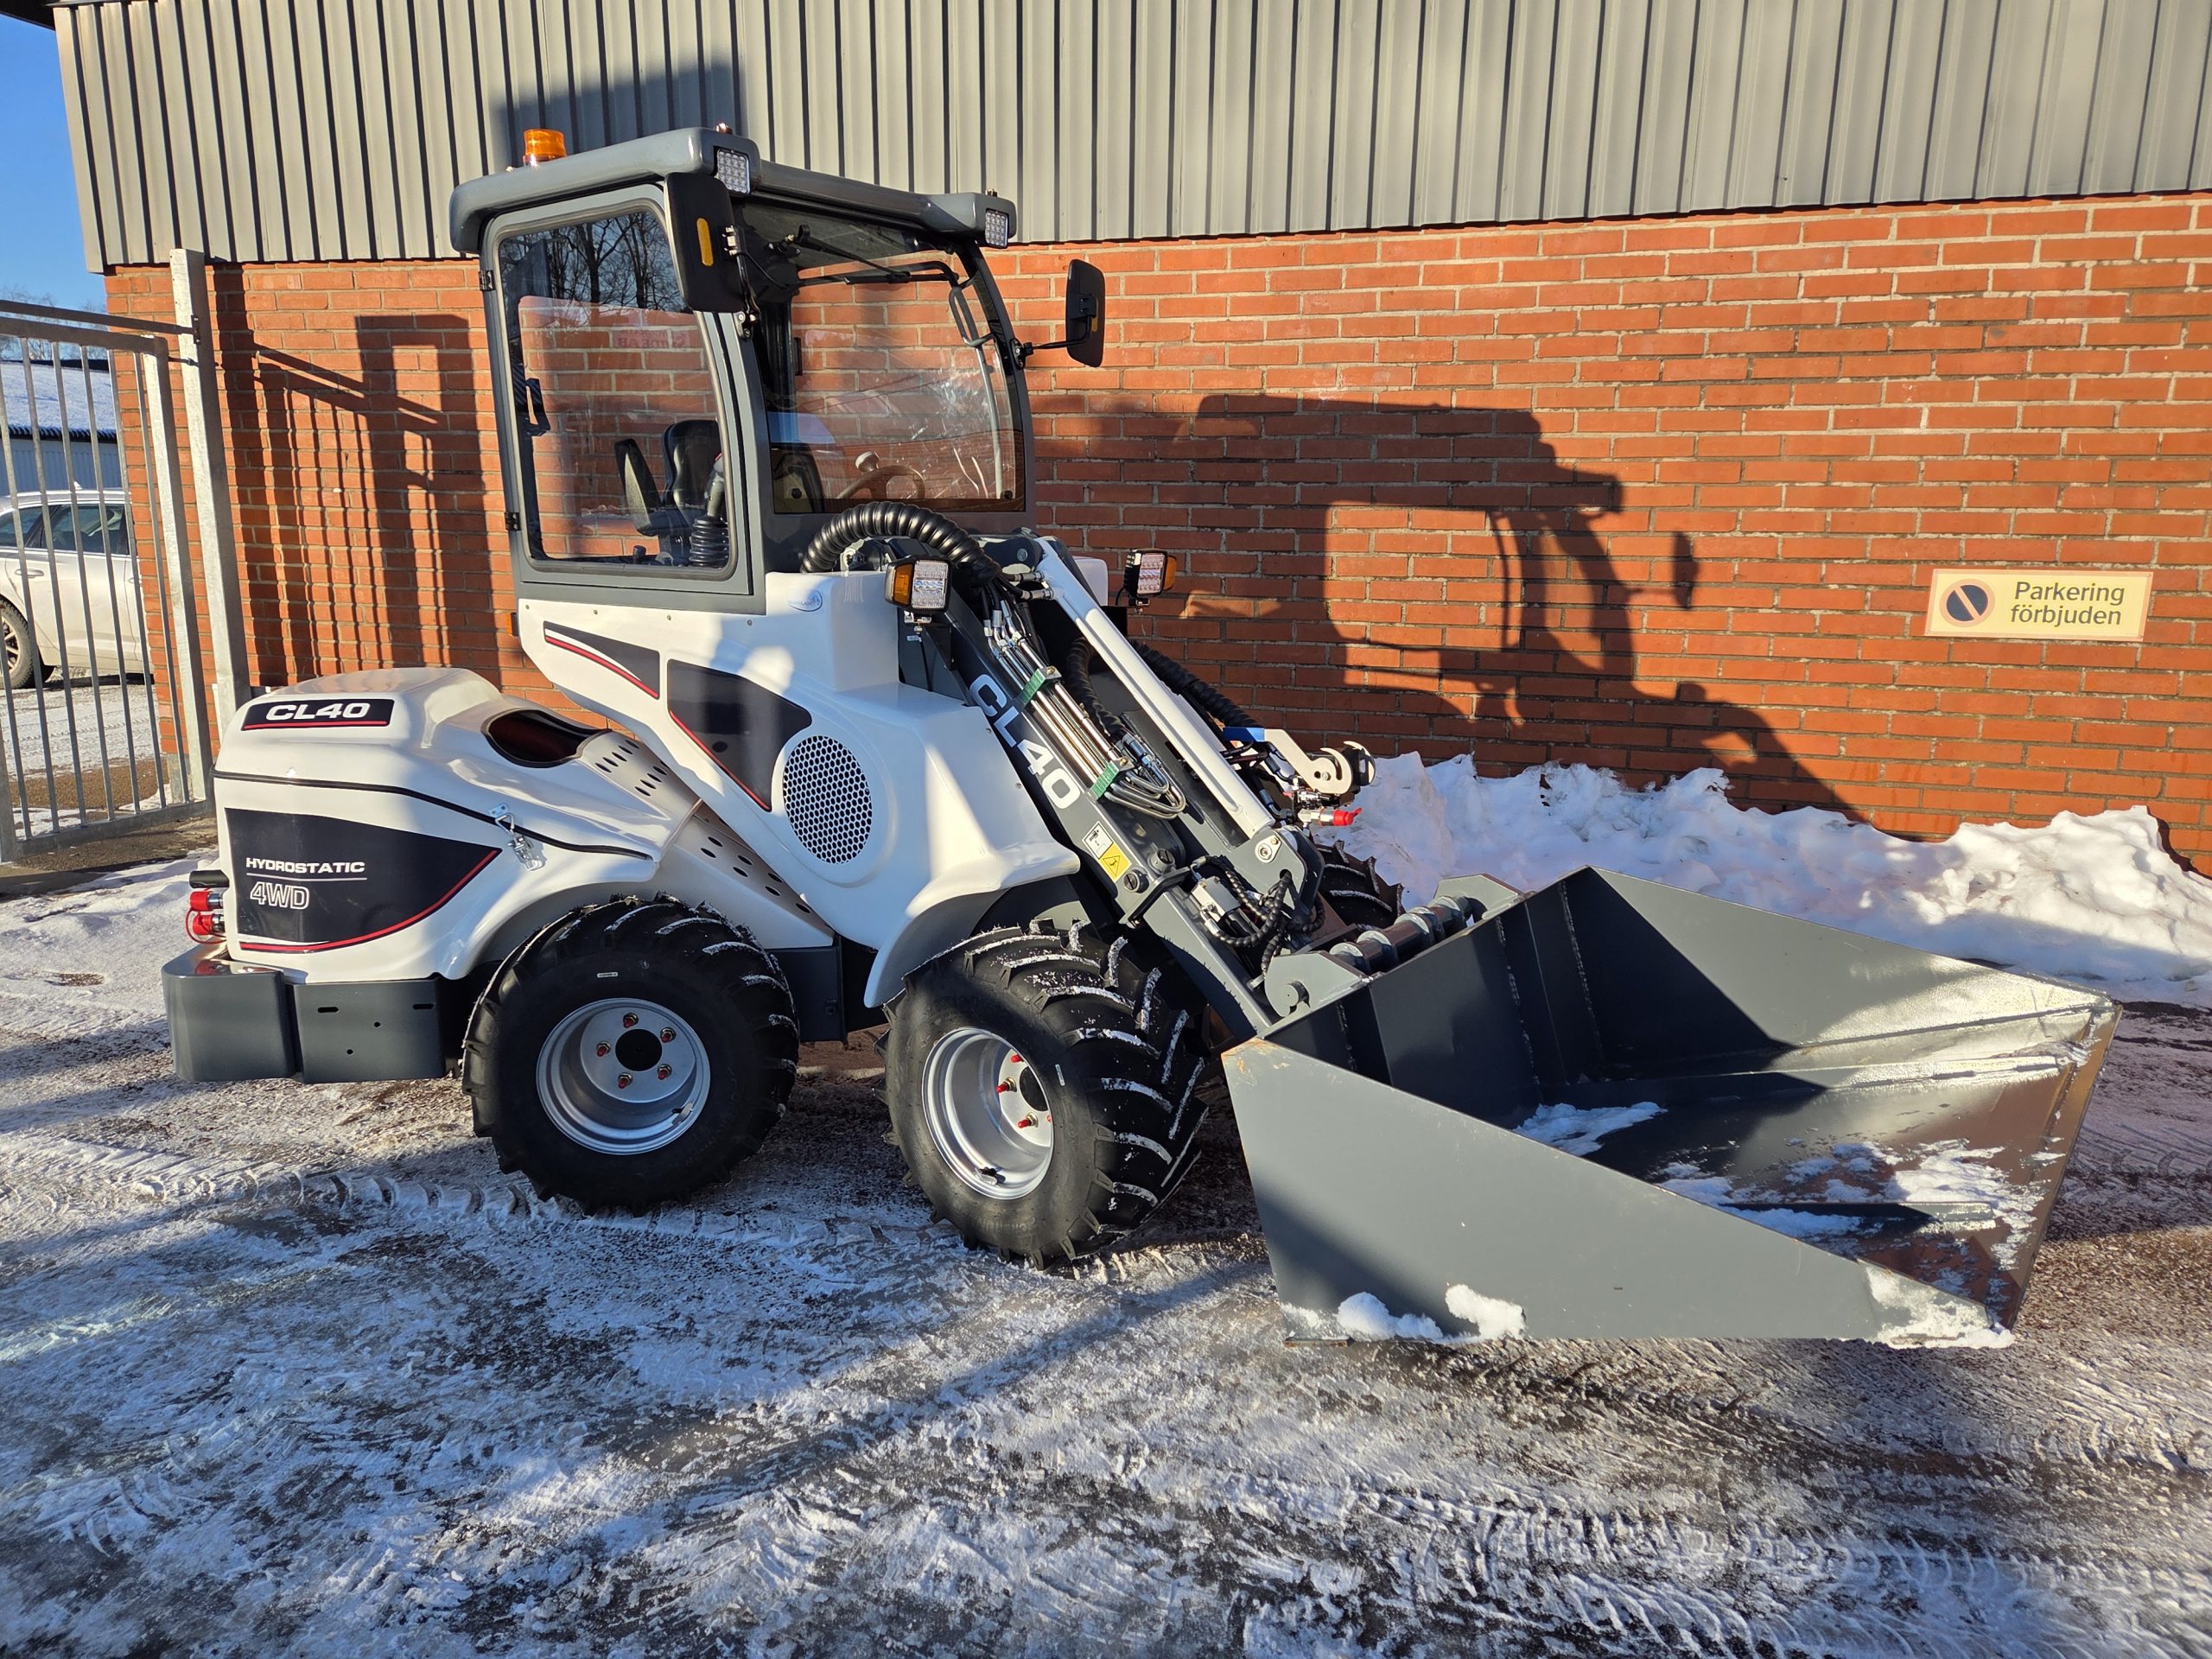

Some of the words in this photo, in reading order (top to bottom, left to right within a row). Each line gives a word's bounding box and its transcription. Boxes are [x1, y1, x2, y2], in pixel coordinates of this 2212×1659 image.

[2014, 581, 2125, 605] Parkering
[2011, 603, 2121, 627] förbjuden
[265, 702, 370, 721] CL40
[969, 673, 1081, 810] CL40
[245, 857, 365, 874] HYDROSTATIC
[250, 881, 310, 910] 4WD
